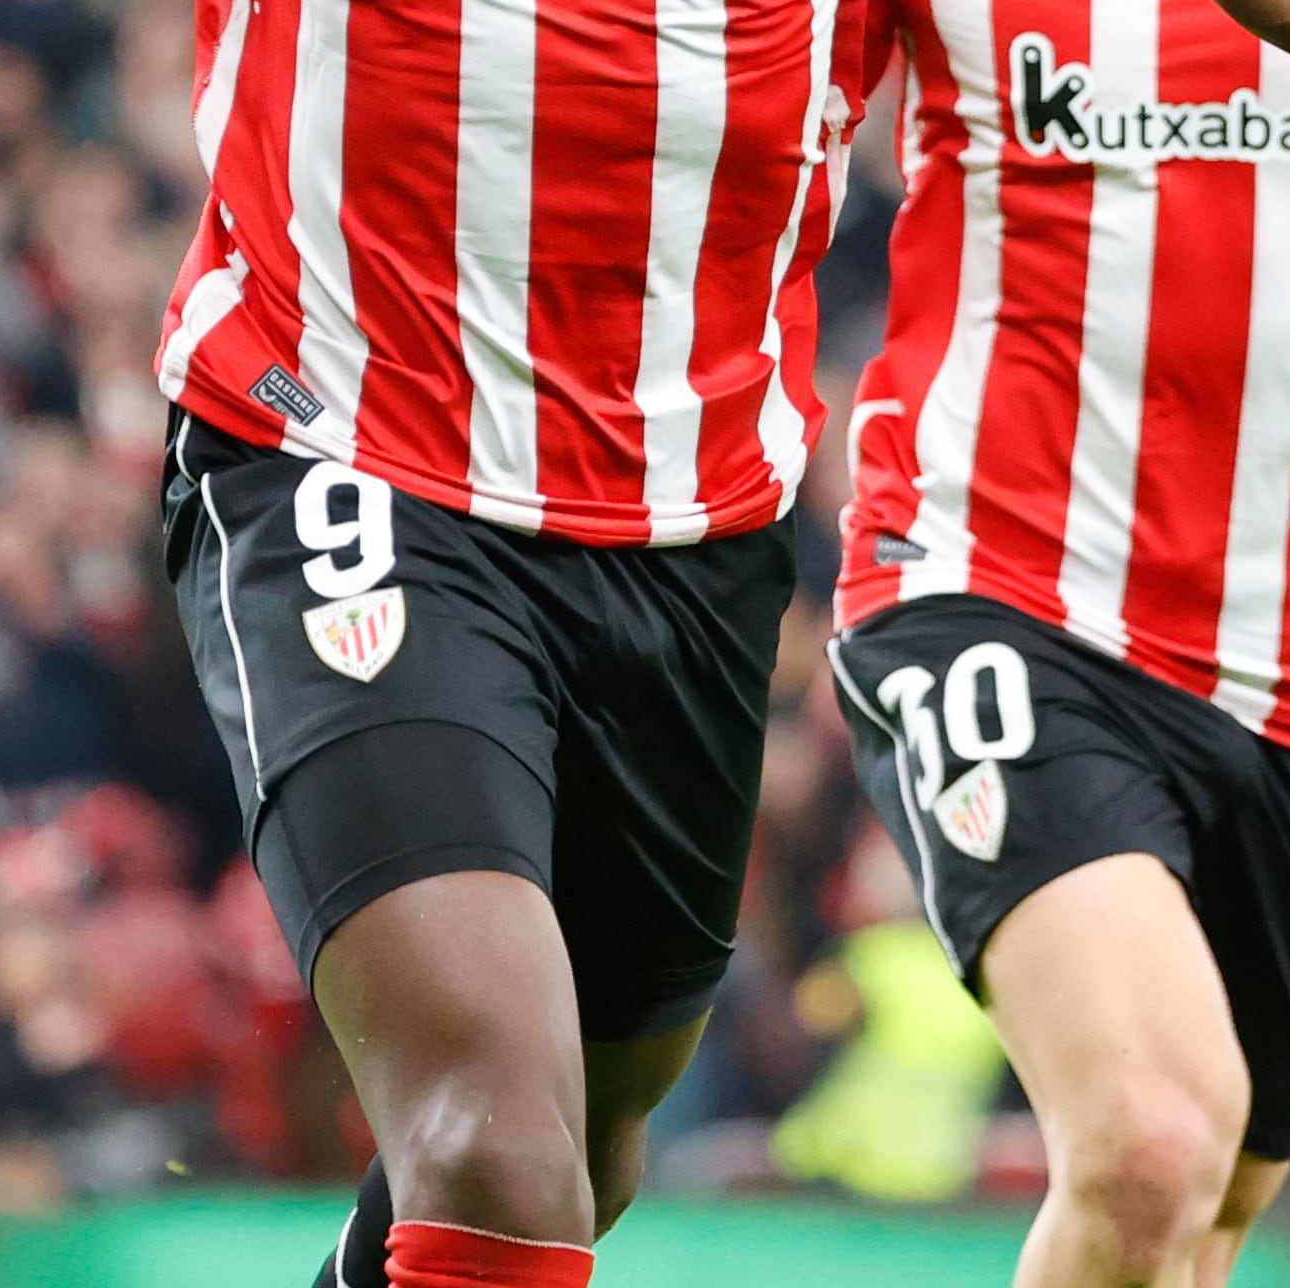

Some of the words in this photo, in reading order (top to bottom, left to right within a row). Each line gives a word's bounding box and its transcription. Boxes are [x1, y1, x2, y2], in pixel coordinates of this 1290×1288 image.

[269, 372, 317, 415] CASTORE
[294, 460, 396, 599] 9
[876, 641, 1037, 811] 30
